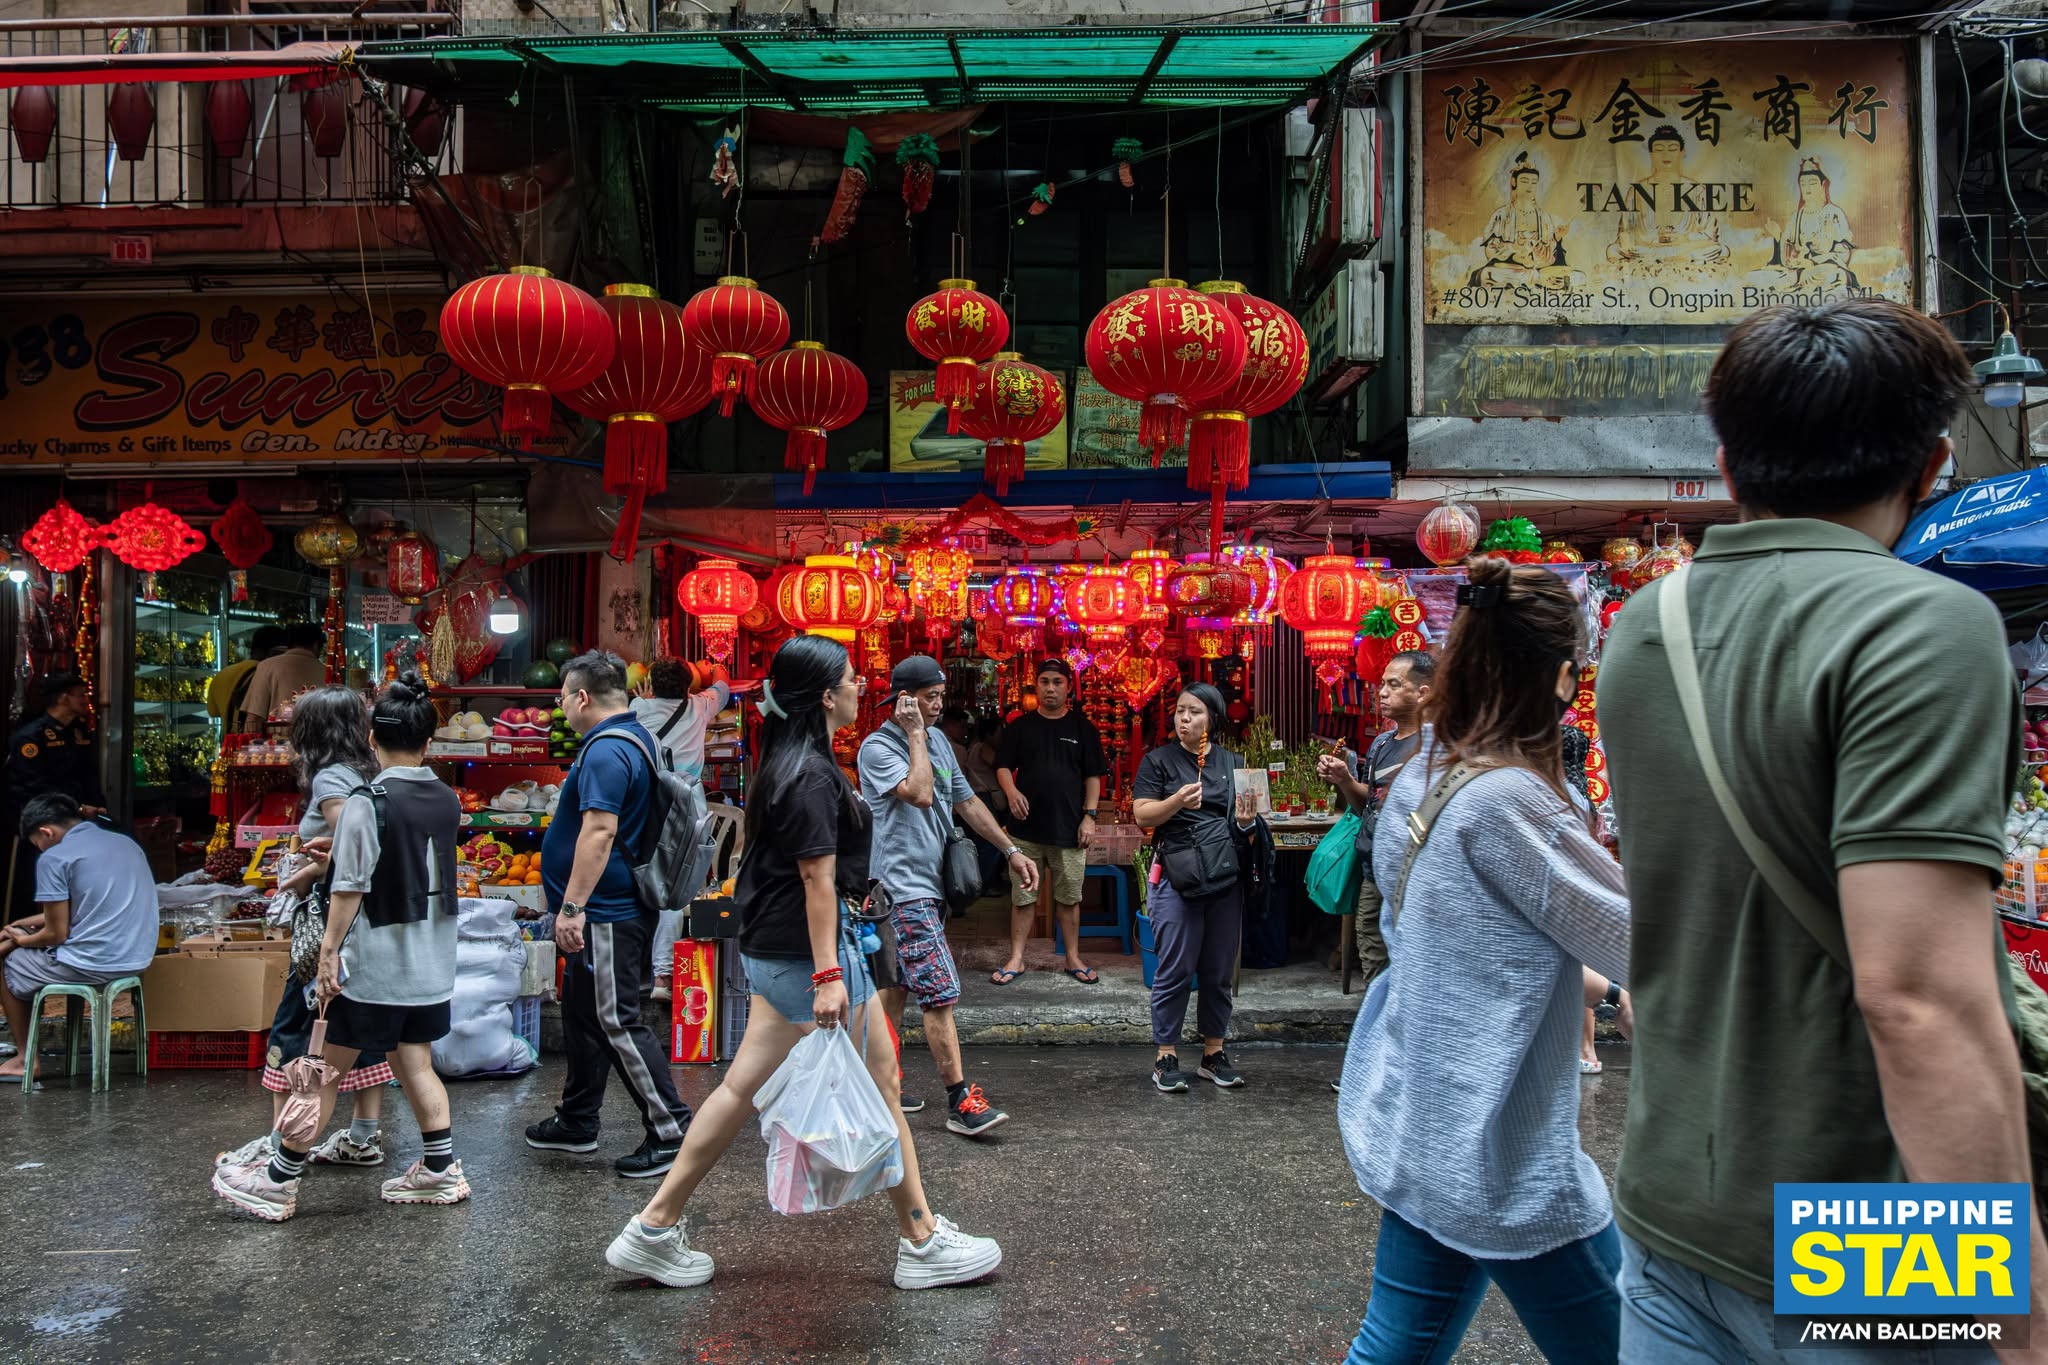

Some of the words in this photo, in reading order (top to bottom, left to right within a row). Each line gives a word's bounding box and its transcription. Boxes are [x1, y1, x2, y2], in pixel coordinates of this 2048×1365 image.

[1441, 74, 1889, 150] 陳記金香商行
[1577, 182, 1658, 212] TAN
[1670, 182, 1755, 212] KEE
[1442, 286, 1504, 308] #807
[1513, 286, 1594, 308] Salazar
[1602, 286, 1640, 312] St.,
[1649, 286, 1735, 312] Ongpin
[1102, 302, 1216, 344] 發財
[1249, 317, 1285, 359] 福
[75, 312, 503, 432] Sunris
[904, 388, 919, 401] FOR
[919, 380, 935, 398] SALE
[0, 438, 38, 459] ucky
[45, 437, 110, 454] Charms
[118, 437, 134, 452] &
[142, 436, 176, 452] Gift
[182, 436, 231, 454] Items
[241, 430, 318, 452] Gen.
[1675, 481, 1705, 497] 807
